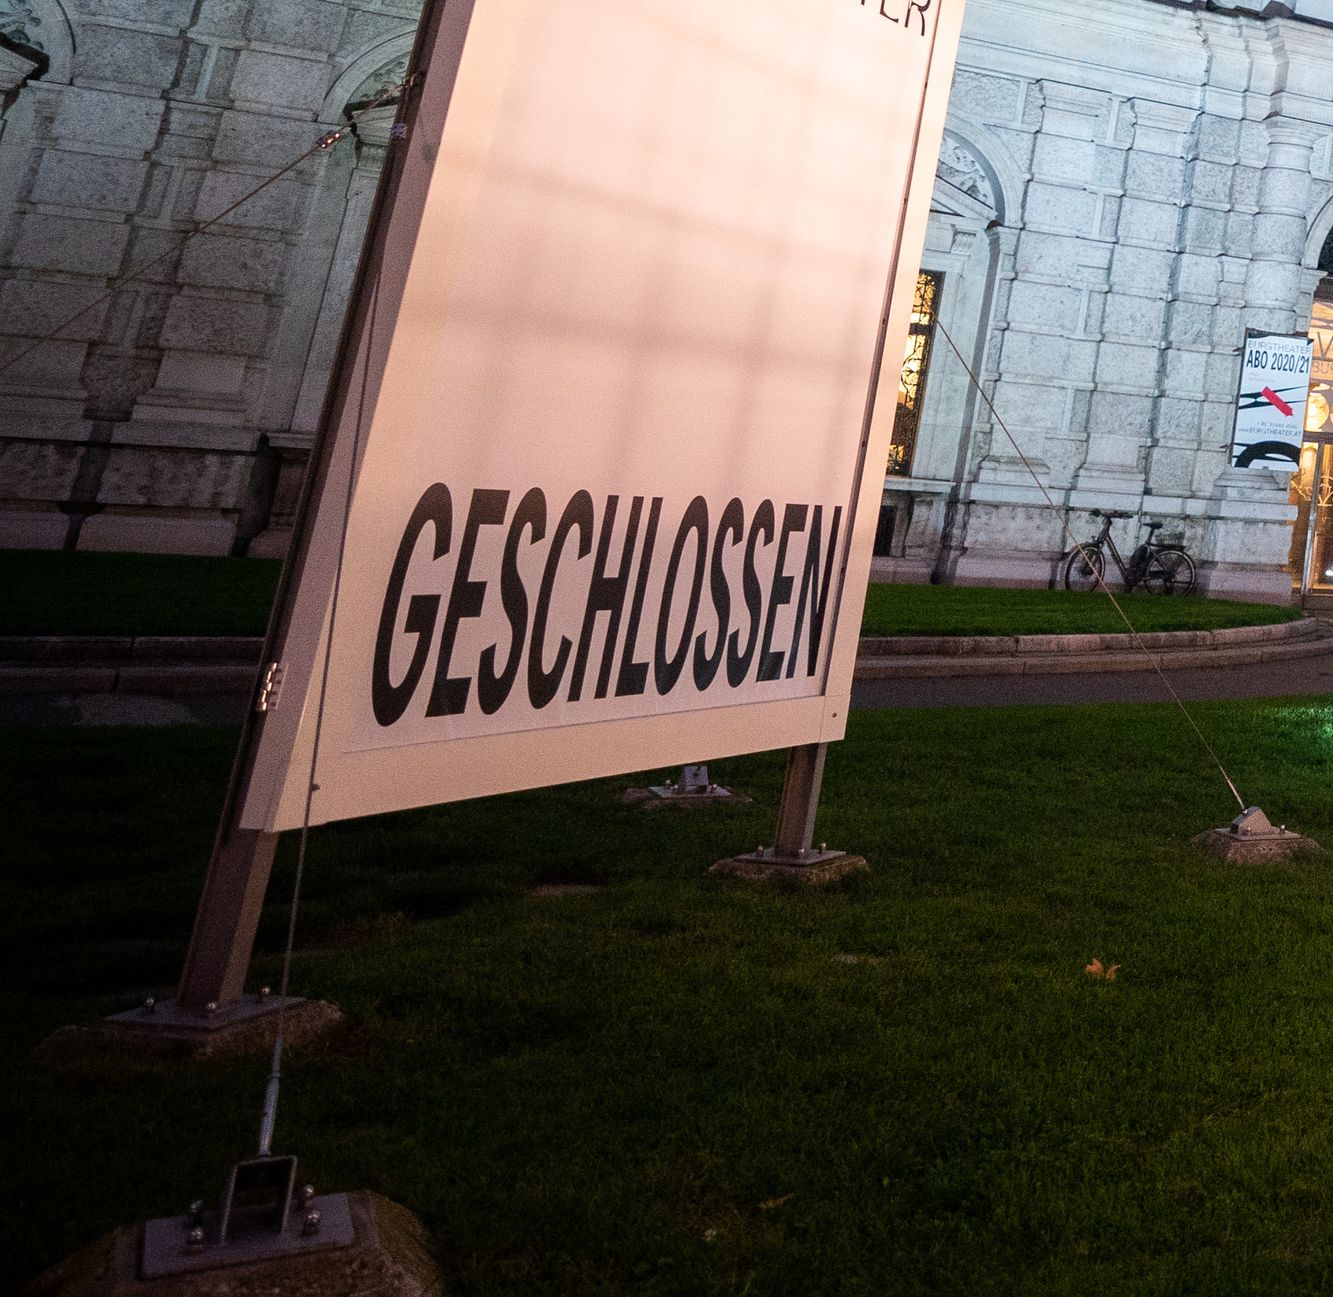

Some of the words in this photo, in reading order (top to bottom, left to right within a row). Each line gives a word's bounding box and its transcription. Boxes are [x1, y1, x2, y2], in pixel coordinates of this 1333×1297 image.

[1248, 340, 1311, 354] BURGTHEATER
[1246, 349, 1268, 369] ABO
[1271, 352, 1310, 374] 2020/21
[371, 482, 843, 728] GESCHLOSSEN
